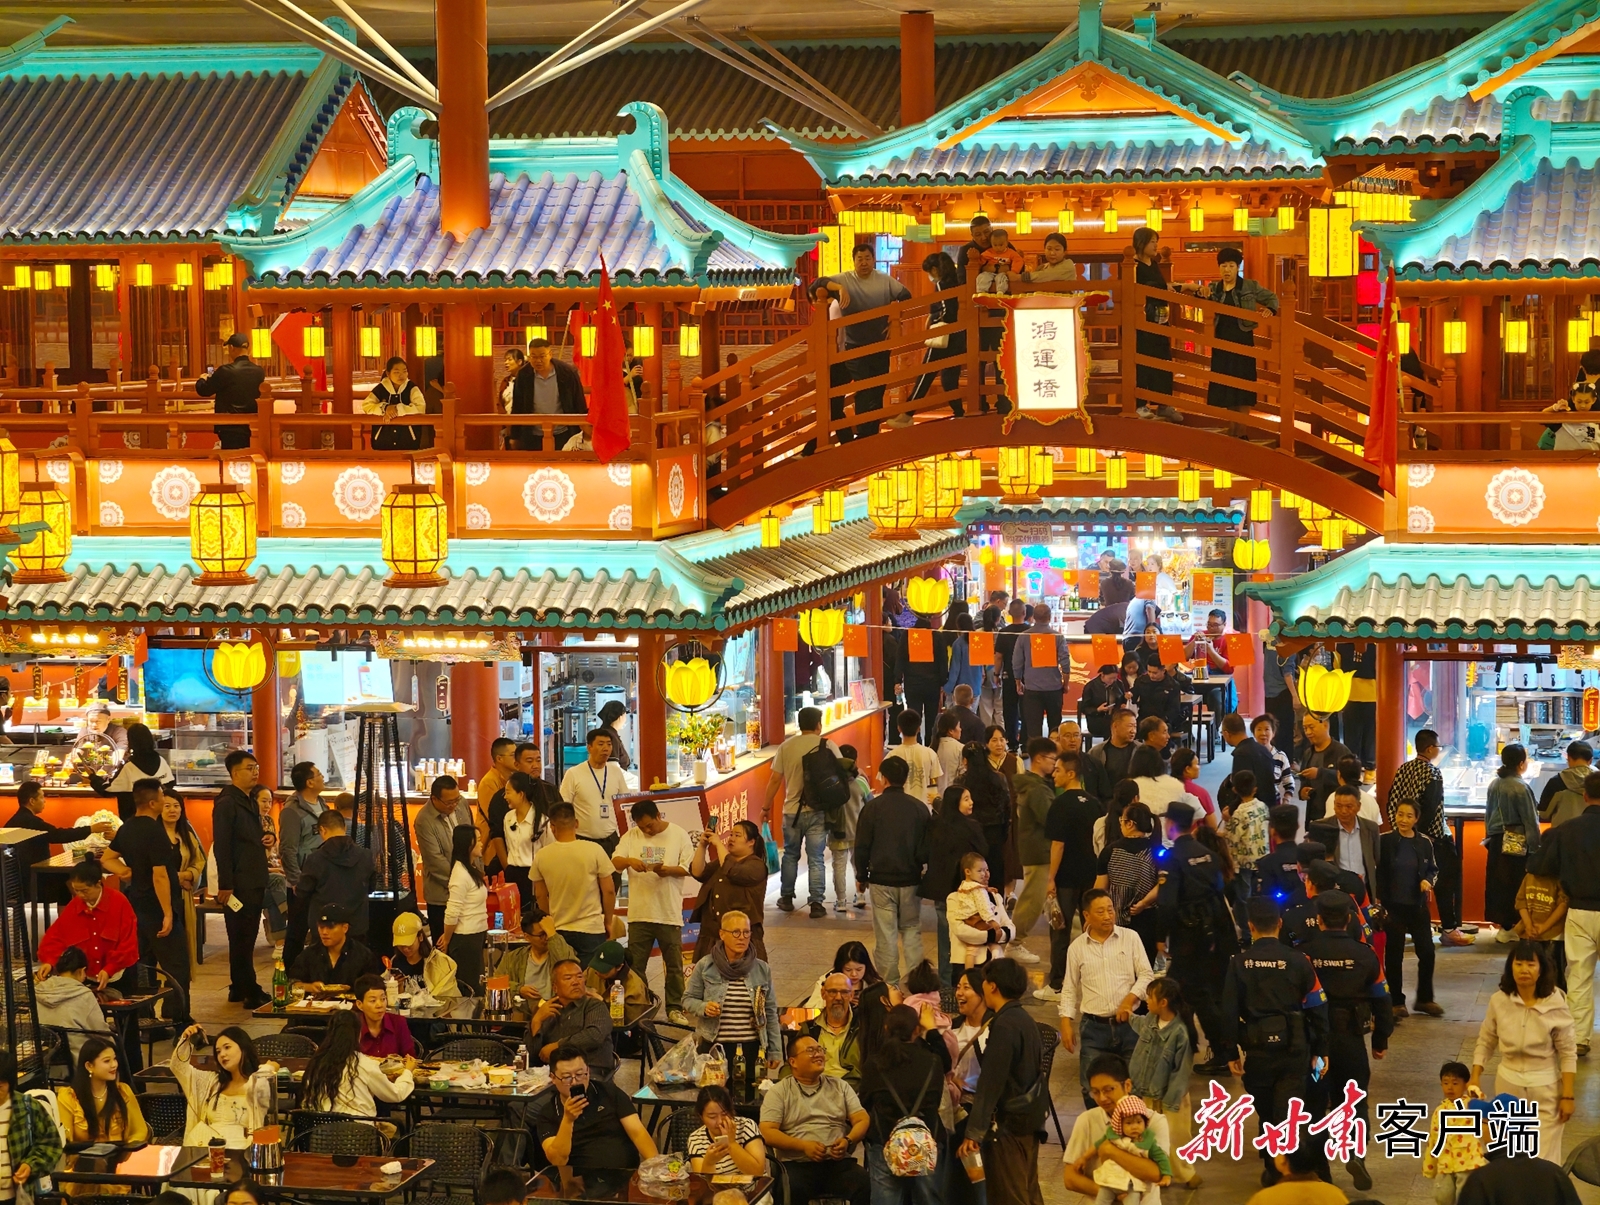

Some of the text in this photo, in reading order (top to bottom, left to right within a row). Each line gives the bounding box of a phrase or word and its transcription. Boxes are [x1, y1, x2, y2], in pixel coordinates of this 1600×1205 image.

[1031, 320, 1060, 398] 鴻運橋
[1536, 892, 1554, 905] Stop
